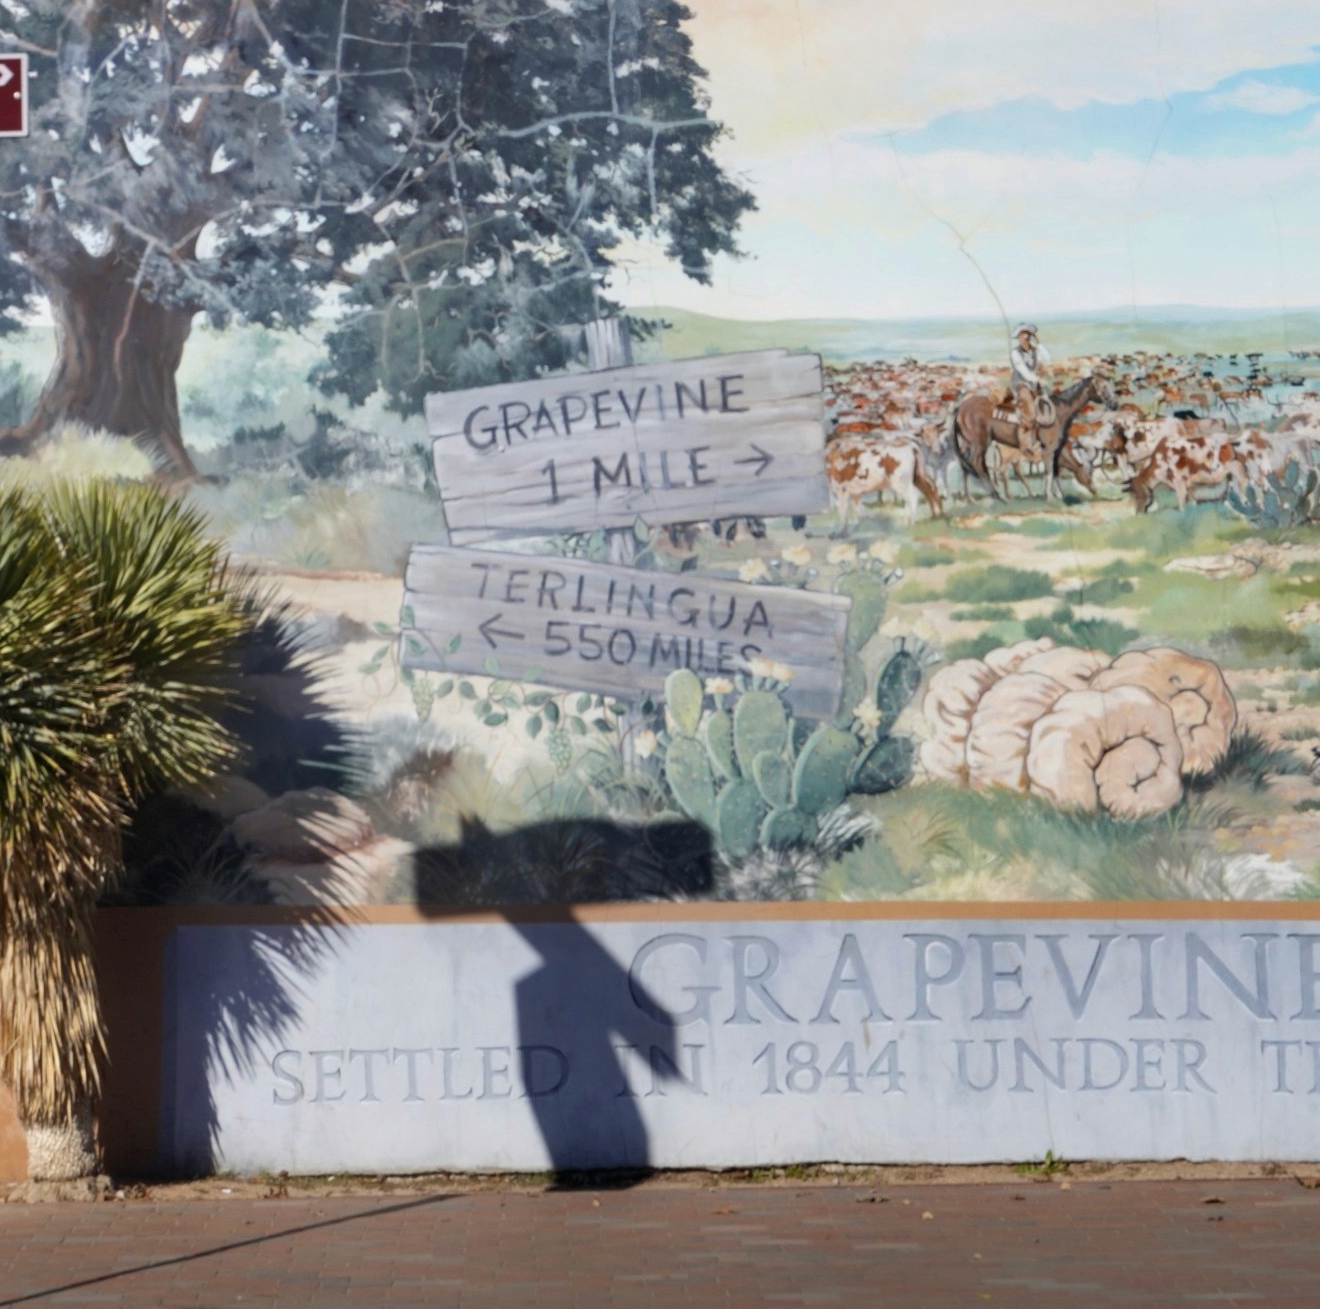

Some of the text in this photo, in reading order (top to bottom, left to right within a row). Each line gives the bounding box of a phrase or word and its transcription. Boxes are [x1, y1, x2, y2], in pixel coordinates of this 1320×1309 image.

[463, 374, 750, 450] GRAPEVINE
[541, 446, 716, 504] 1 MILE
[470, 562, 775, 639] TERLINGUA
[544, 620, 637, 666] 550
[271, 1045, 570, 1106] SETTLED
[612, 1043, 707, 1098] IN
[751, 1039, 906, 1096] 1844
[952, 1038, 1218, 1094] UNDER
